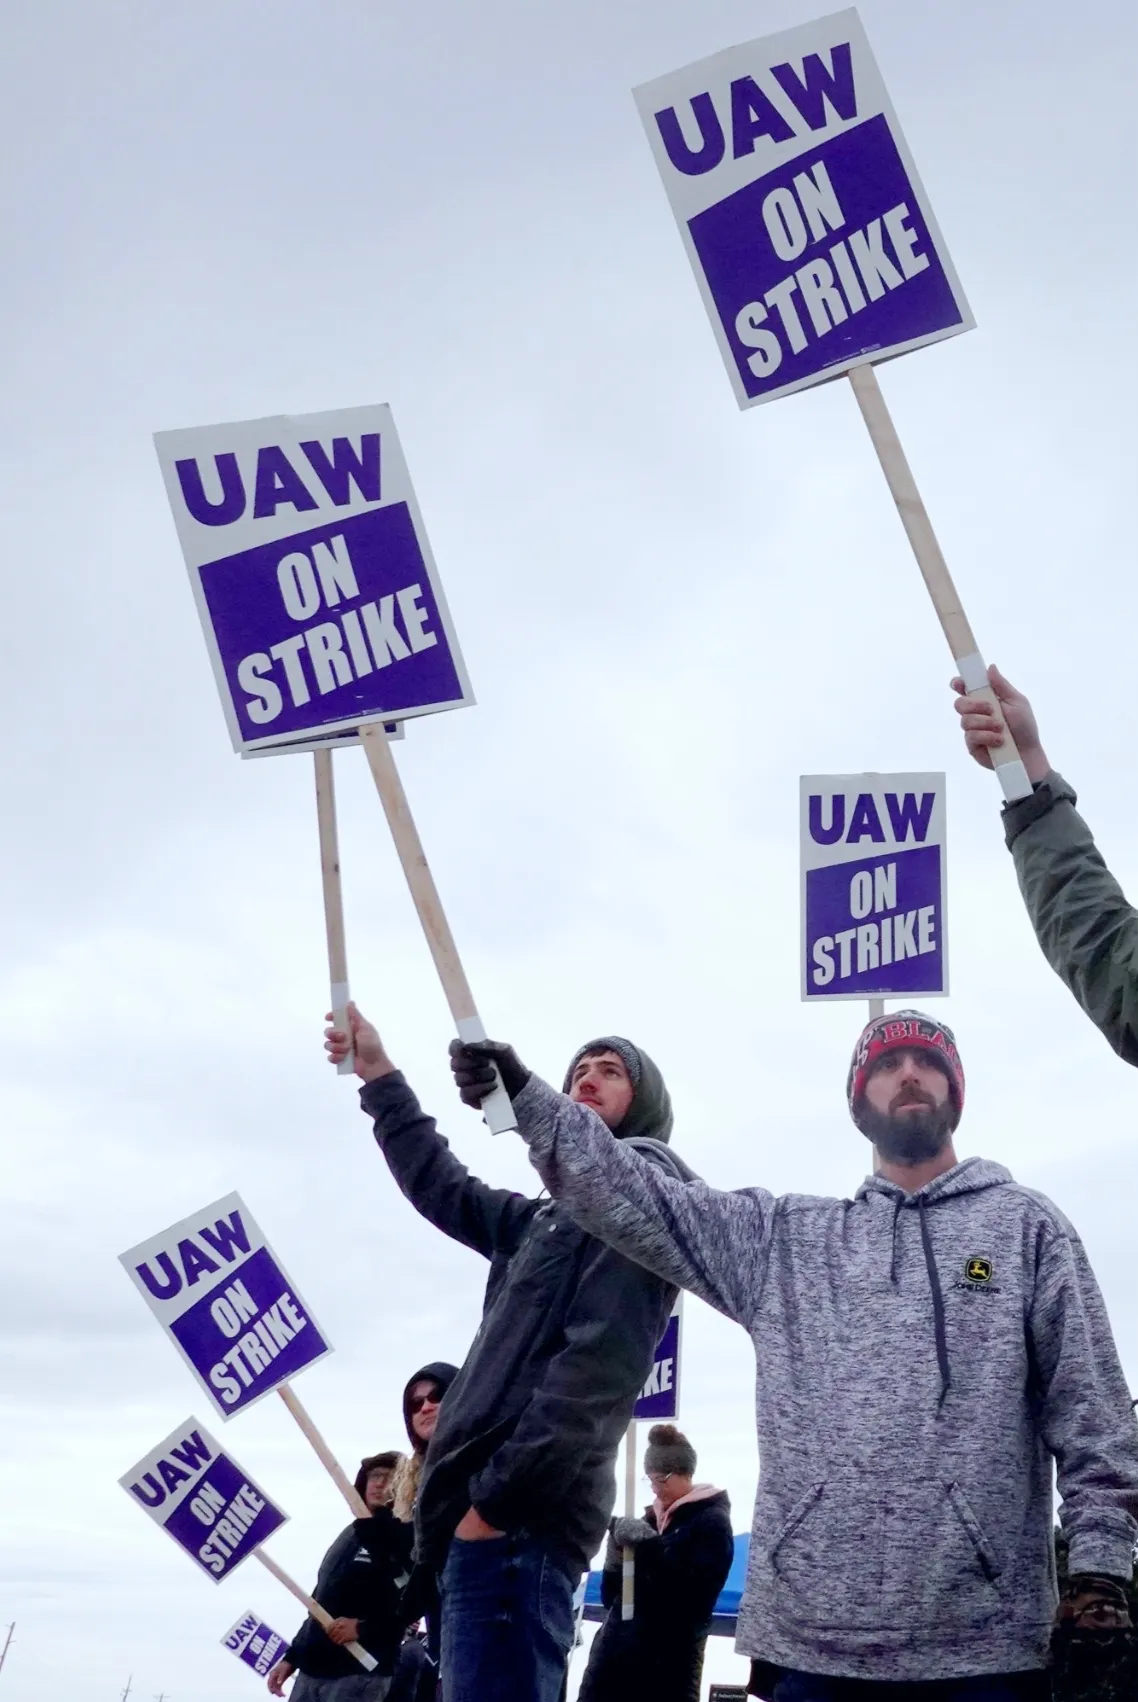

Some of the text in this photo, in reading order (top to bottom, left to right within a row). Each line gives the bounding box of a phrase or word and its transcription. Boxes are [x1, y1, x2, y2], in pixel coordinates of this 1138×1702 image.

[654, 42, 858, 176] UAW
[762, 160, 846, 262] ON
[735, 202, 930, 379] STRIKE
[175, 433, 381, 527] UAW
[277, 534, 360, 621] ON
[237, 583, 437, 725] STRIKE
[809, 792, 936, 845] UAW
[850, 863, 897, 919] ON
[812, 904, 936, 986] STRIKE
[135, 1210, 252, 1300] UAW
[209, 1292, 307, 1404] STRIKE
[210, 1278, 259, 1339] ON
[130, 1430, 212, 1508] UAW
[190, 1481, 227, 1526] ON
[199, 1483, 265, 1573] STRIKE
[225, 1615, 258, 1650] UAW
[249, 1634, 266, 1655] ON
[254, 1633, 283, 1674] STRIKE
